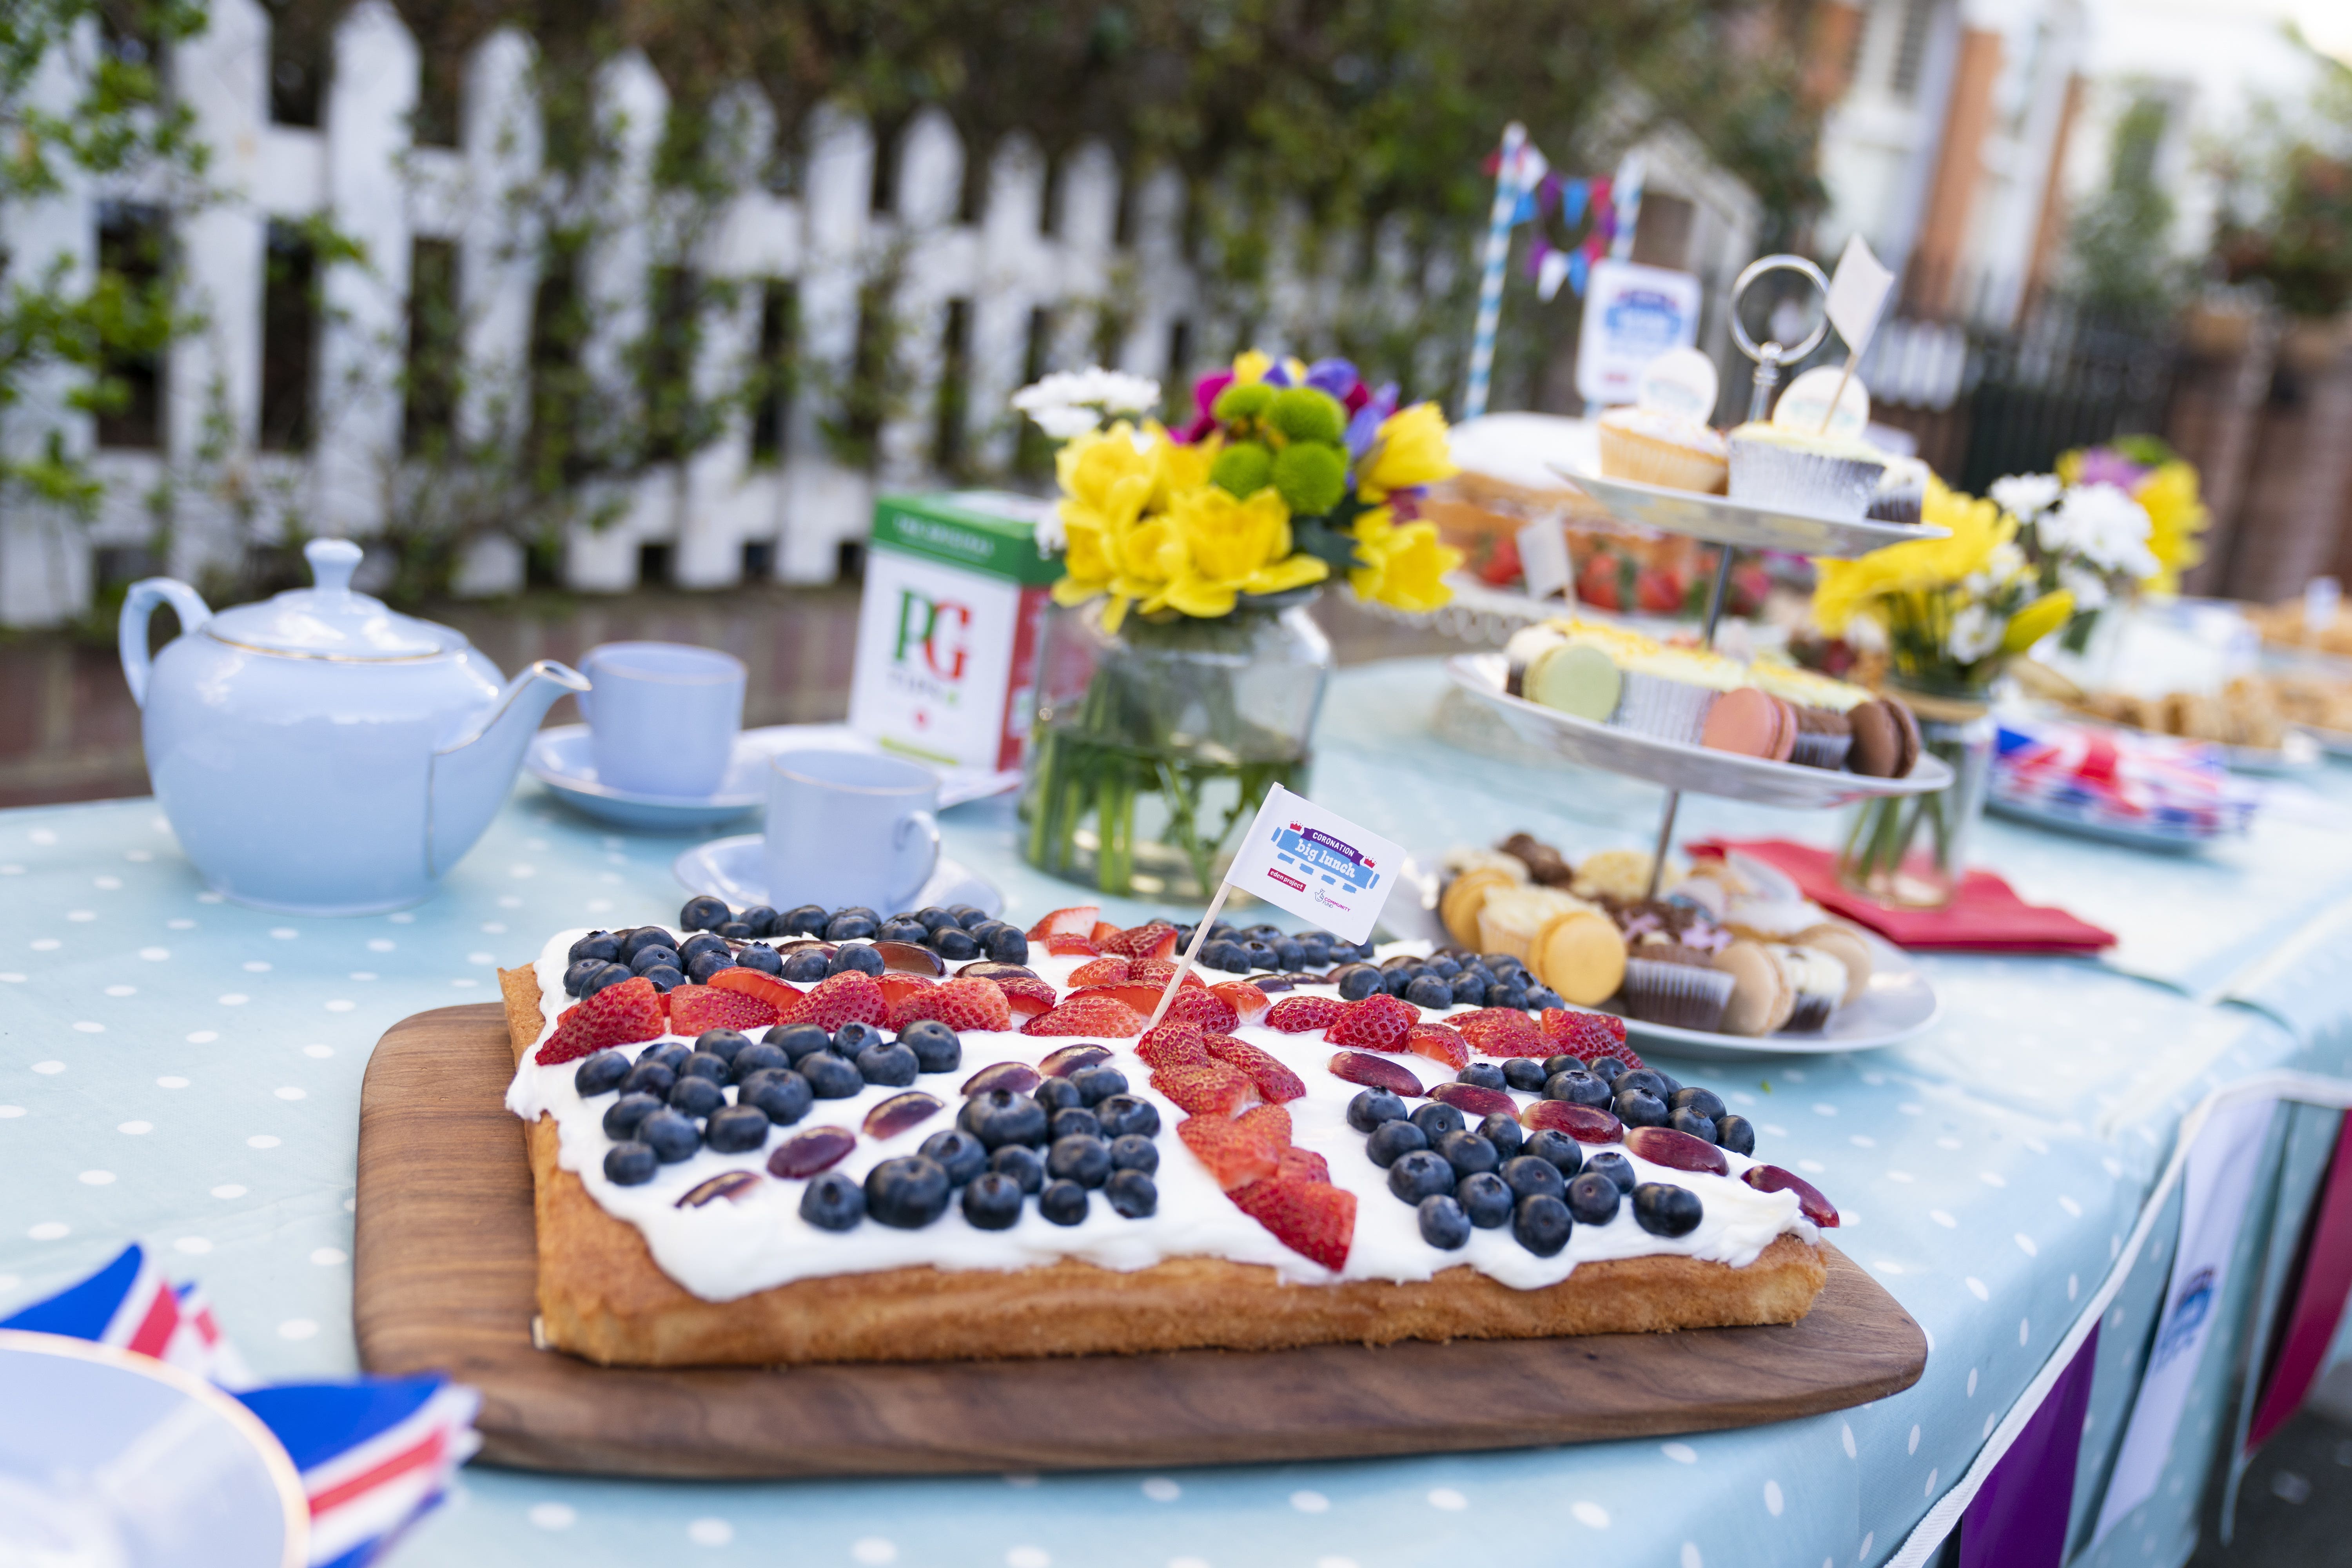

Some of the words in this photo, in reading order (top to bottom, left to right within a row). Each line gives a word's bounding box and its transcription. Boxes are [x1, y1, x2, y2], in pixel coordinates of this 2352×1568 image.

[894, 589, 972, 680] PG
[1312, 832, 1355, 857] CORONATION
[1295, 839, 1319, 862] big
[1318, 850, 1355, 878] lunch
[1270, 870, 1284, 880] eden
[1283, 876, 1303, 889] project
[1324, 897, 1350, 912] COMMUNITY
